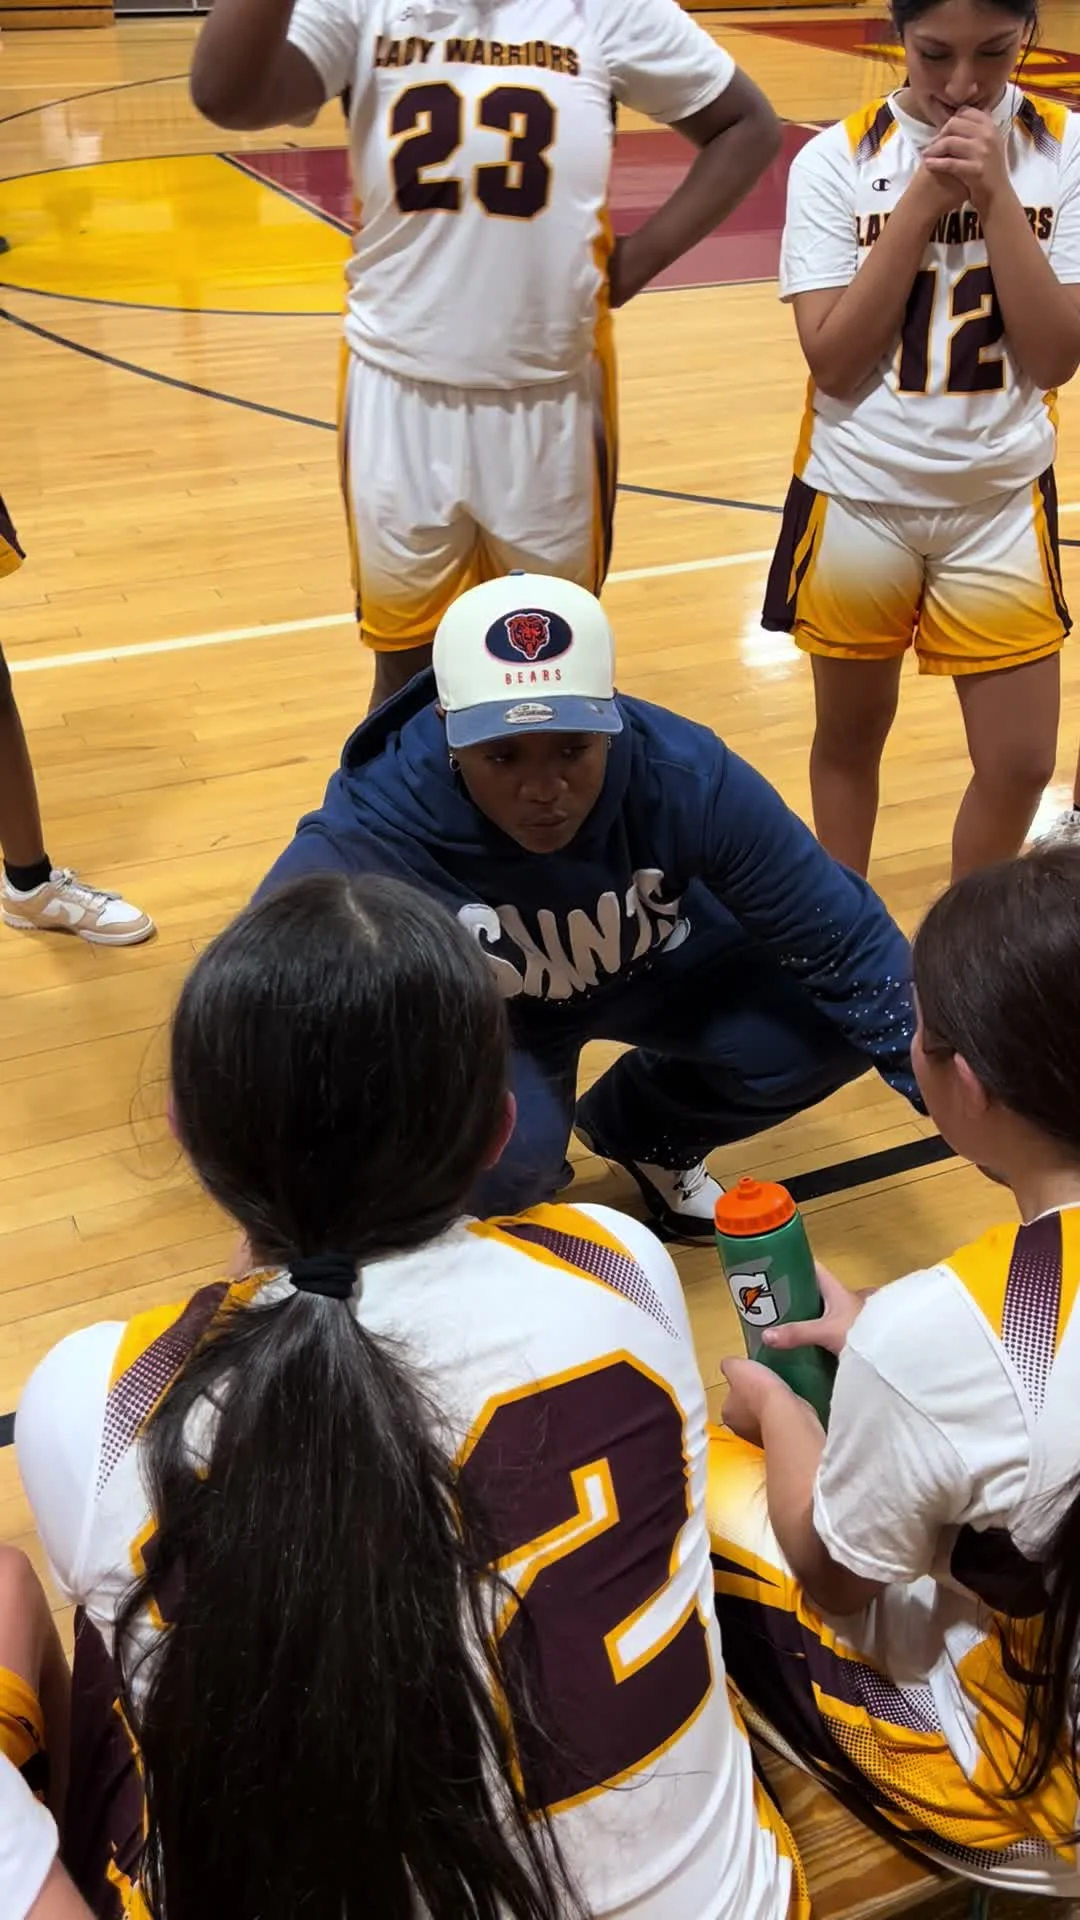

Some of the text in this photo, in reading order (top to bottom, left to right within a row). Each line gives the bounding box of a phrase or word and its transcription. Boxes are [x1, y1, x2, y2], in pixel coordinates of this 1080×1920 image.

[374, 35, 580, 77] LADY WARRIORS
[387, 80, 559, 222] 23
[855, 211, 892, 248] LA
[896, 261, 1008, 397] 12
[504, 668, 563, 686] BEARS
